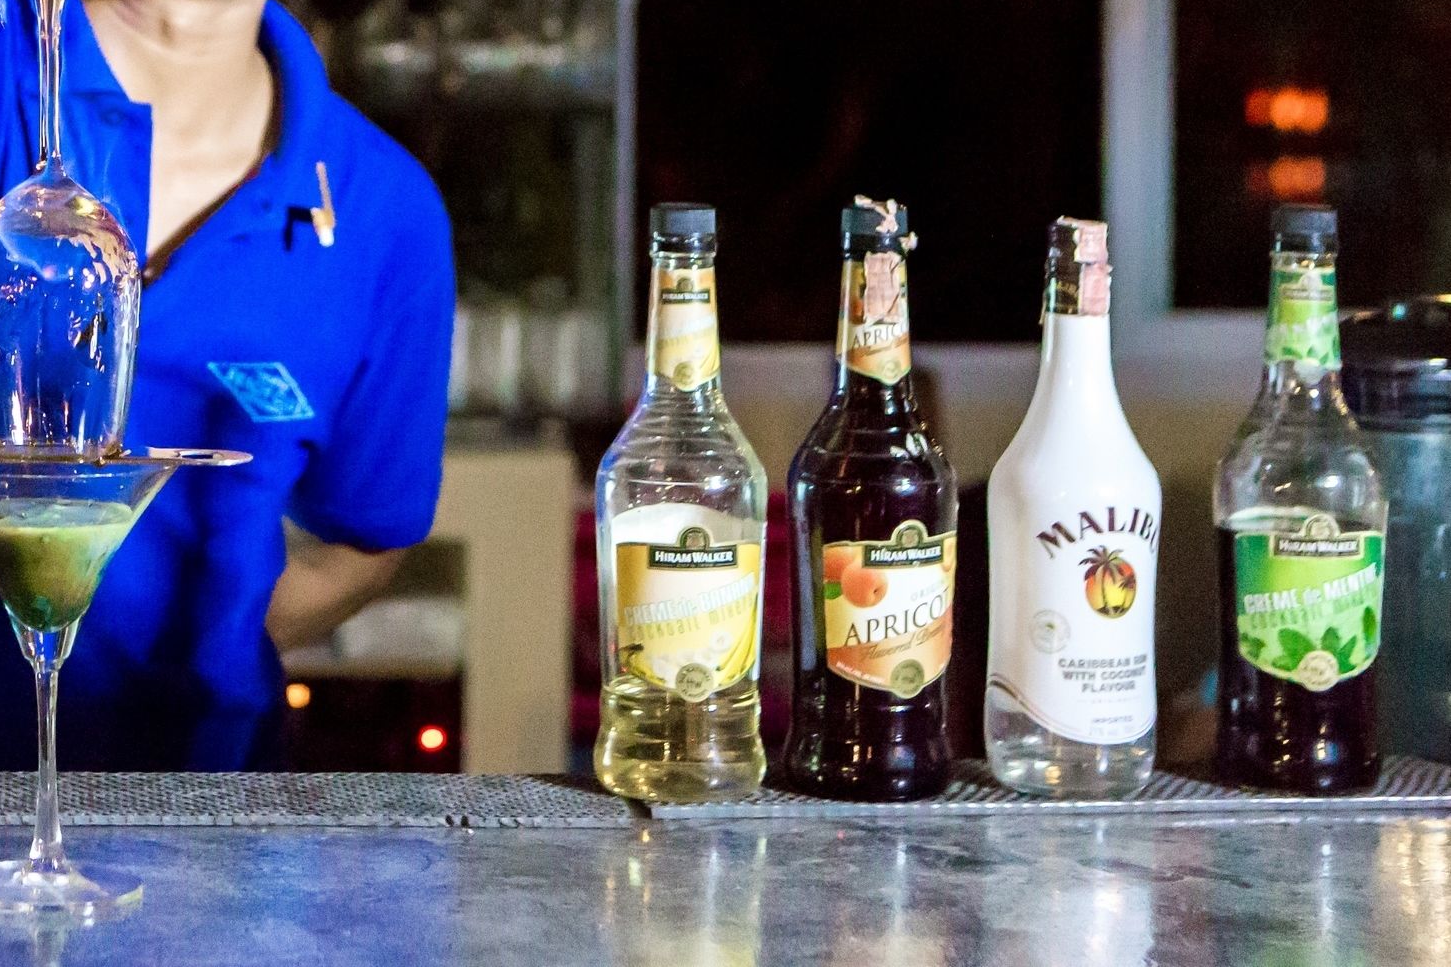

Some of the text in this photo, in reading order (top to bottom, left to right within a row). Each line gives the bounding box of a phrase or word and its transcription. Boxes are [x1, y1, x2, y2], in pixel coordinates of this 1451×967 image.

[655, 550, 734, 563] HIRAM WALKER
[870, 545, 942, 562] HIRAM WALKER
